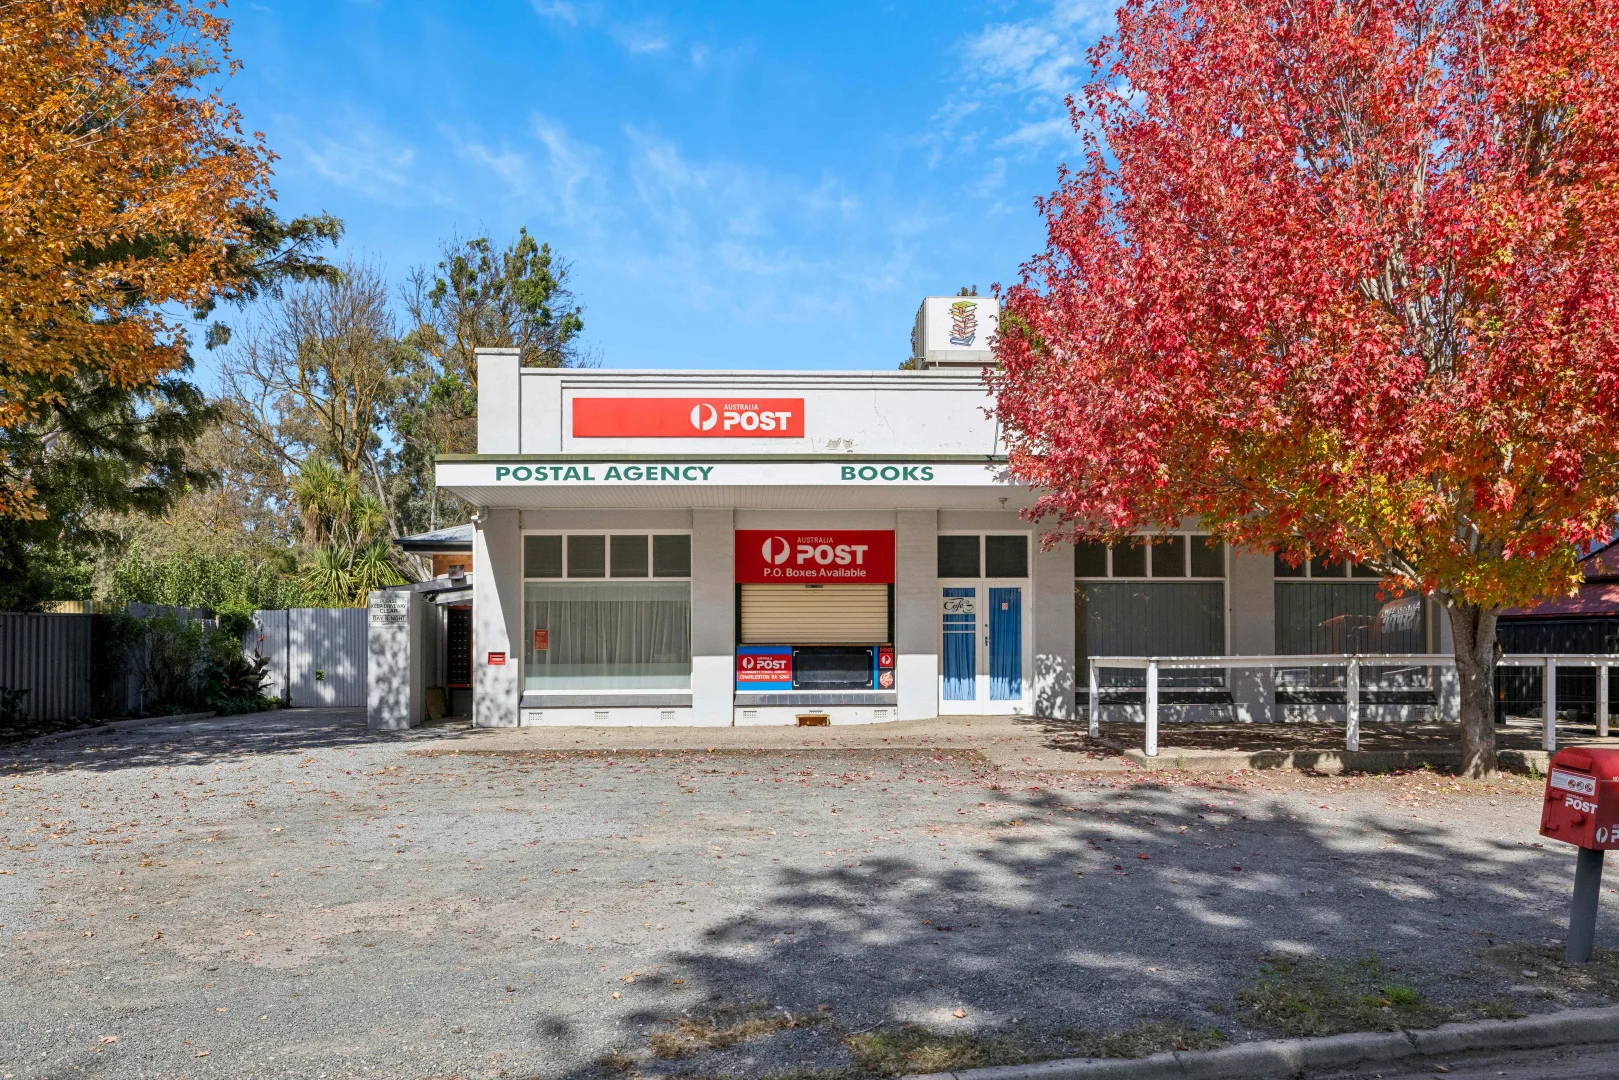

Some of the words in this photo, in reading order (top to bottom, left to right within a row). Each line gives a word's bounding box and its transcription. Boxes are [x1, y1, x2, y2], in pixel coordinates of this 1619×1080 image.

[723, 411, 792, 431] POST
[495, 466, 595, 481] POSTAL
[604, 466, 714, 481] AGENCY
[841, 466, 934, 481] BOOKS
[797, 544, 868, 565] POST
[763, 568, 784, 577] P.O.
[786, 568, 817, 577] Boxes
[819, 568, 867, 577] Available
[757, 660, 786, 669] POST
[1565, 797, 1598, 814] POST
